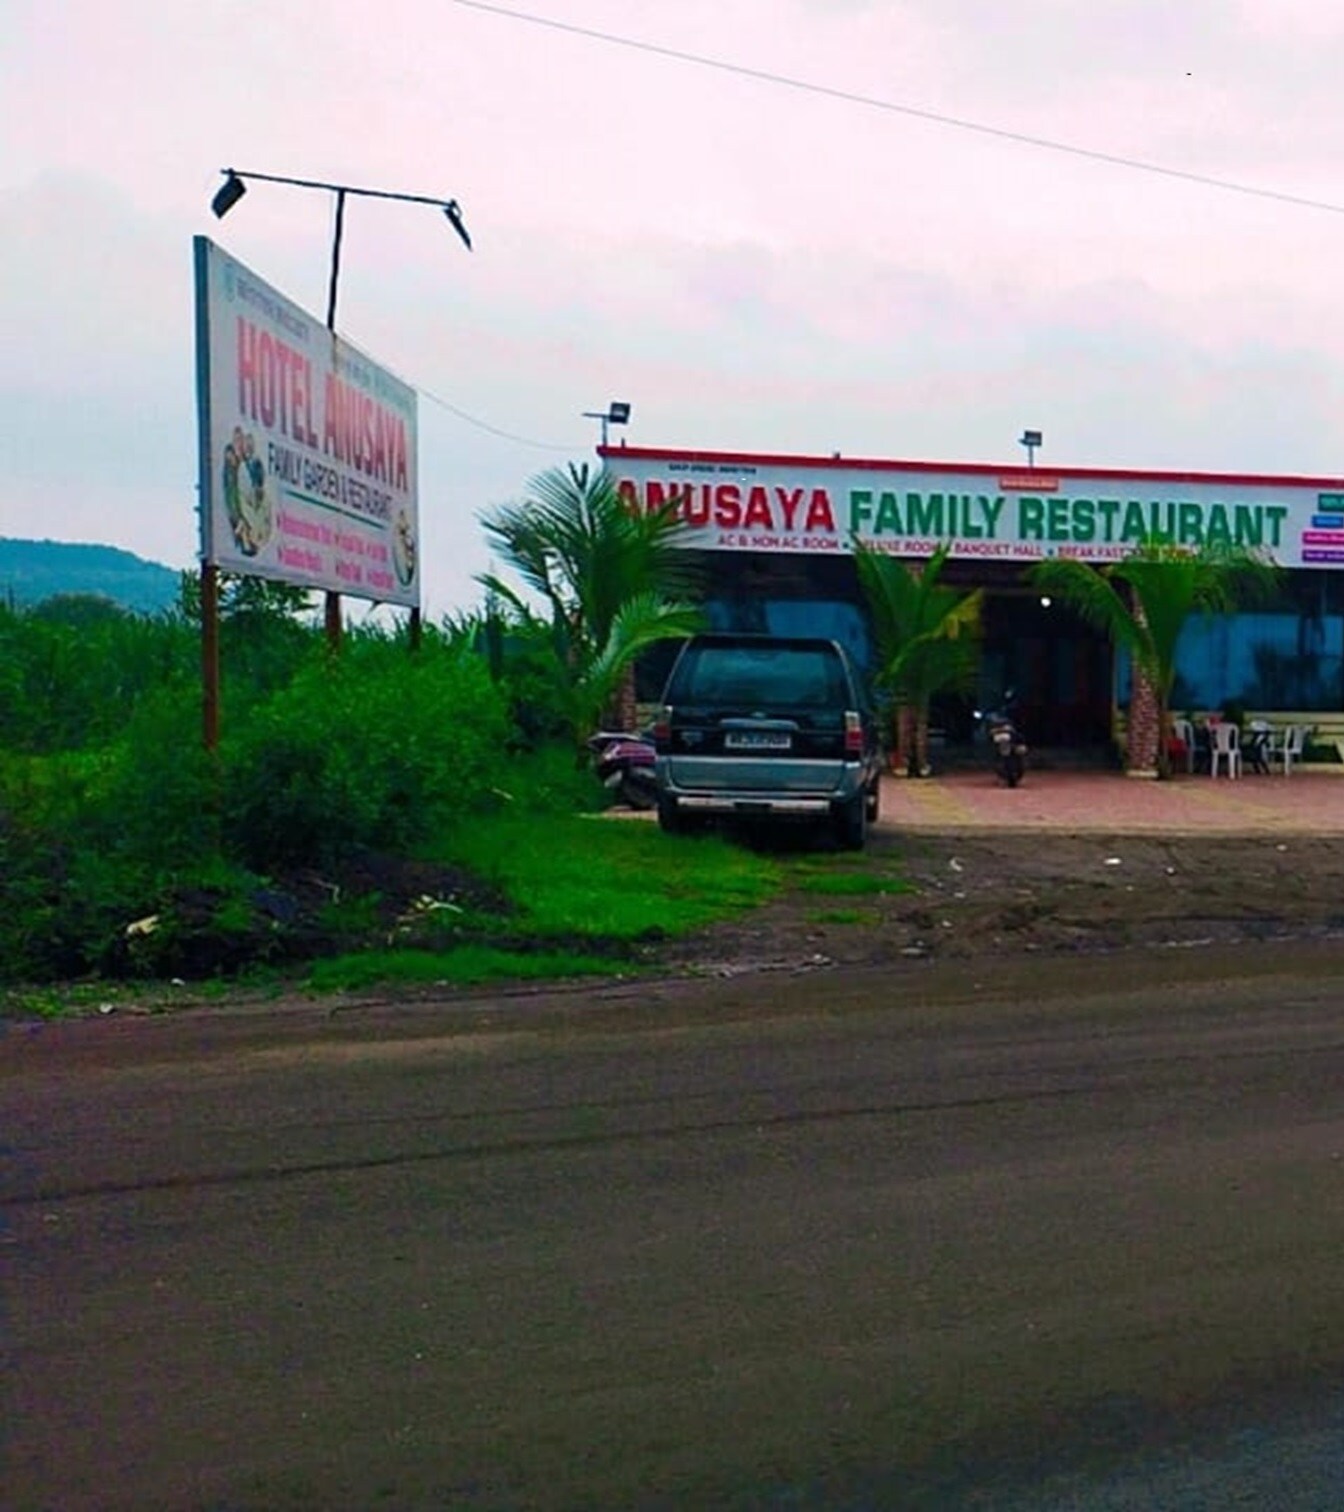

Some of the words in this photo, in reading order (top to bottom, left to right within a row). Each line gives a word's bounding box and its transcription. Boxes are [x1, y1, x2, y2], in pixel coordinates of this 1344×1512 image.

[238, 315, 317, 449] HOTEL
[324, 370, 408, 491] ANUSAYA
[618, 480, 835, 532] ANUSAYA
[849, 490, 1005, 538] FAMILY
[1019, 497, 1287, 549] RESTAURANT
[803, 537, 838, 550] ROOM
